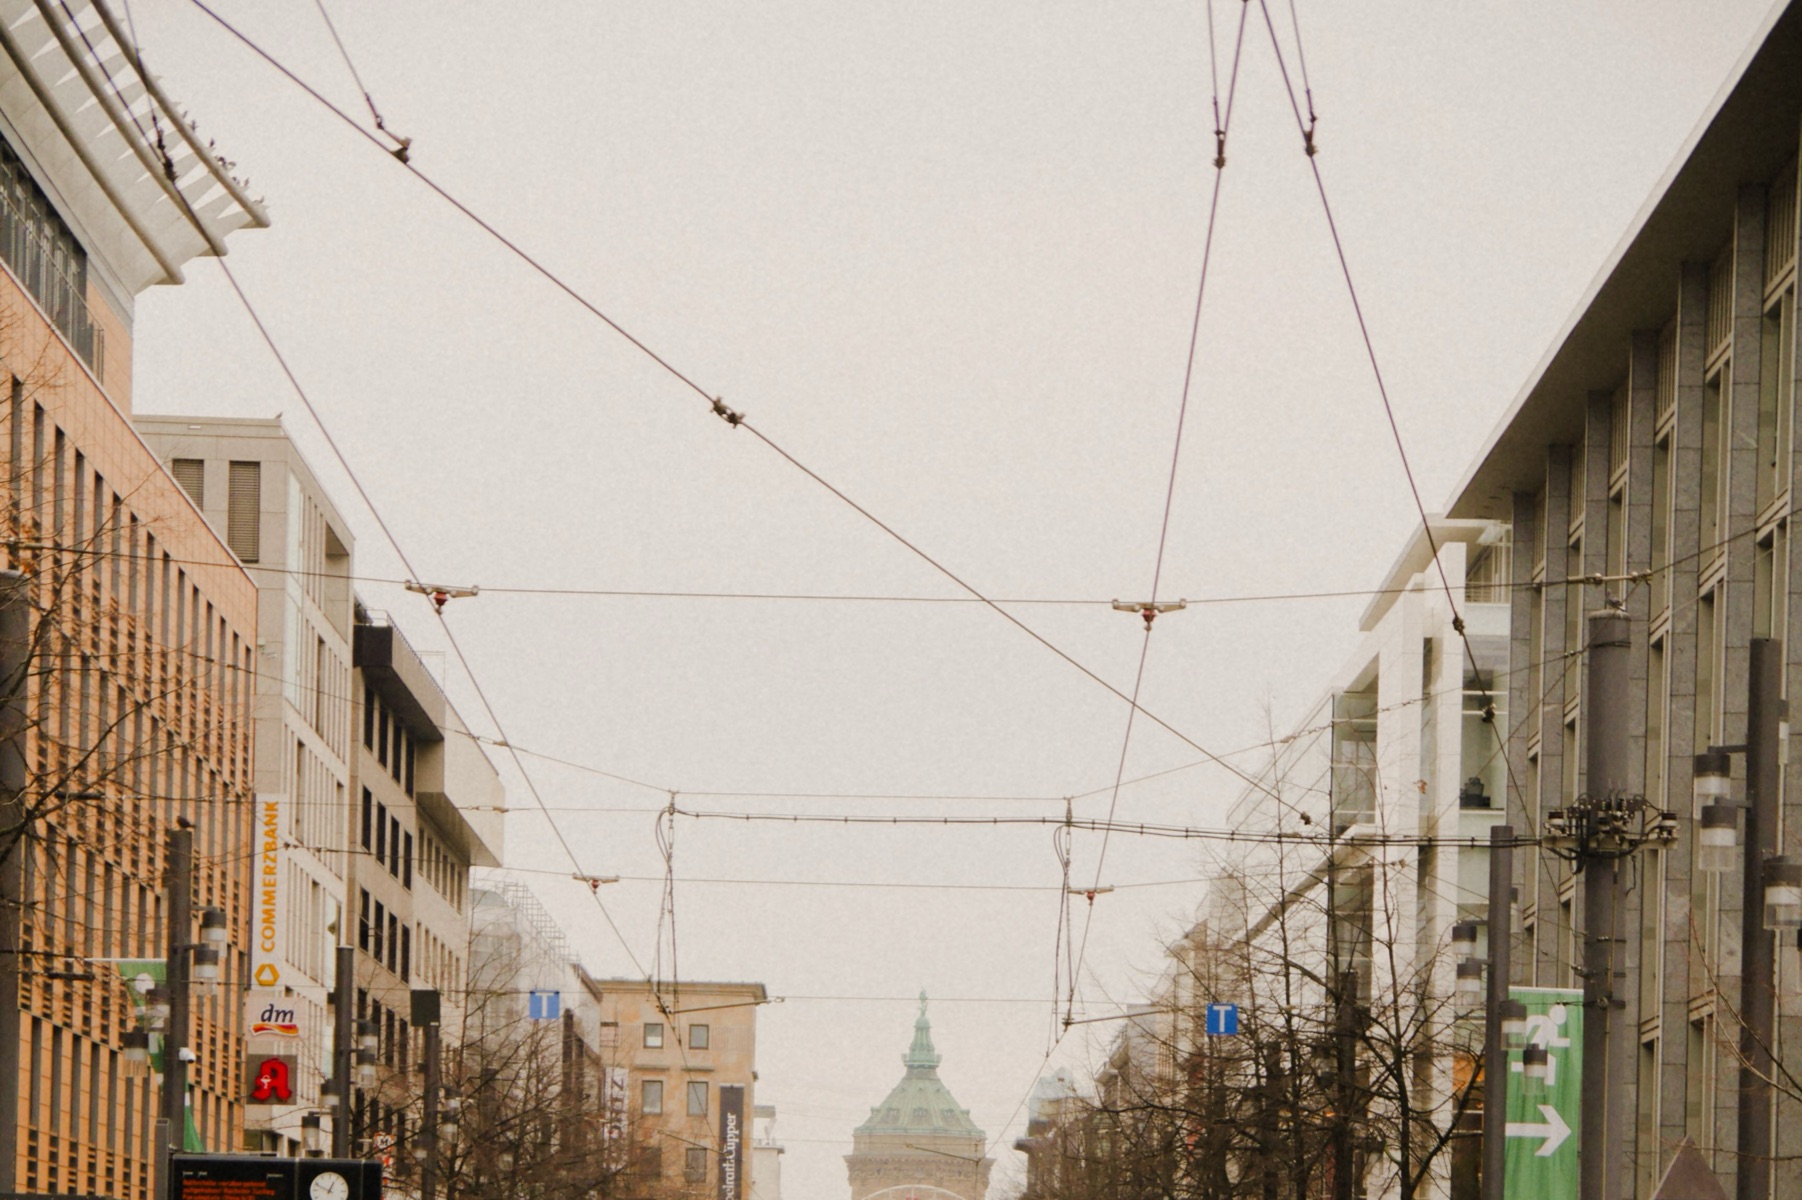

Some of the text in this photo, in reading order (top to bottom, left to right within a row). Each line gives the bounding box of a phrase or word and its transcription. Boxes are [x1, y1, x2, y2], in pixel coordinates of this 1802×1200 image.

[260, 801, 279, 953] COMMERZBANK
[261, 1003, 294, 1022] dm
[1213, 1005, 1232, 1032] T
